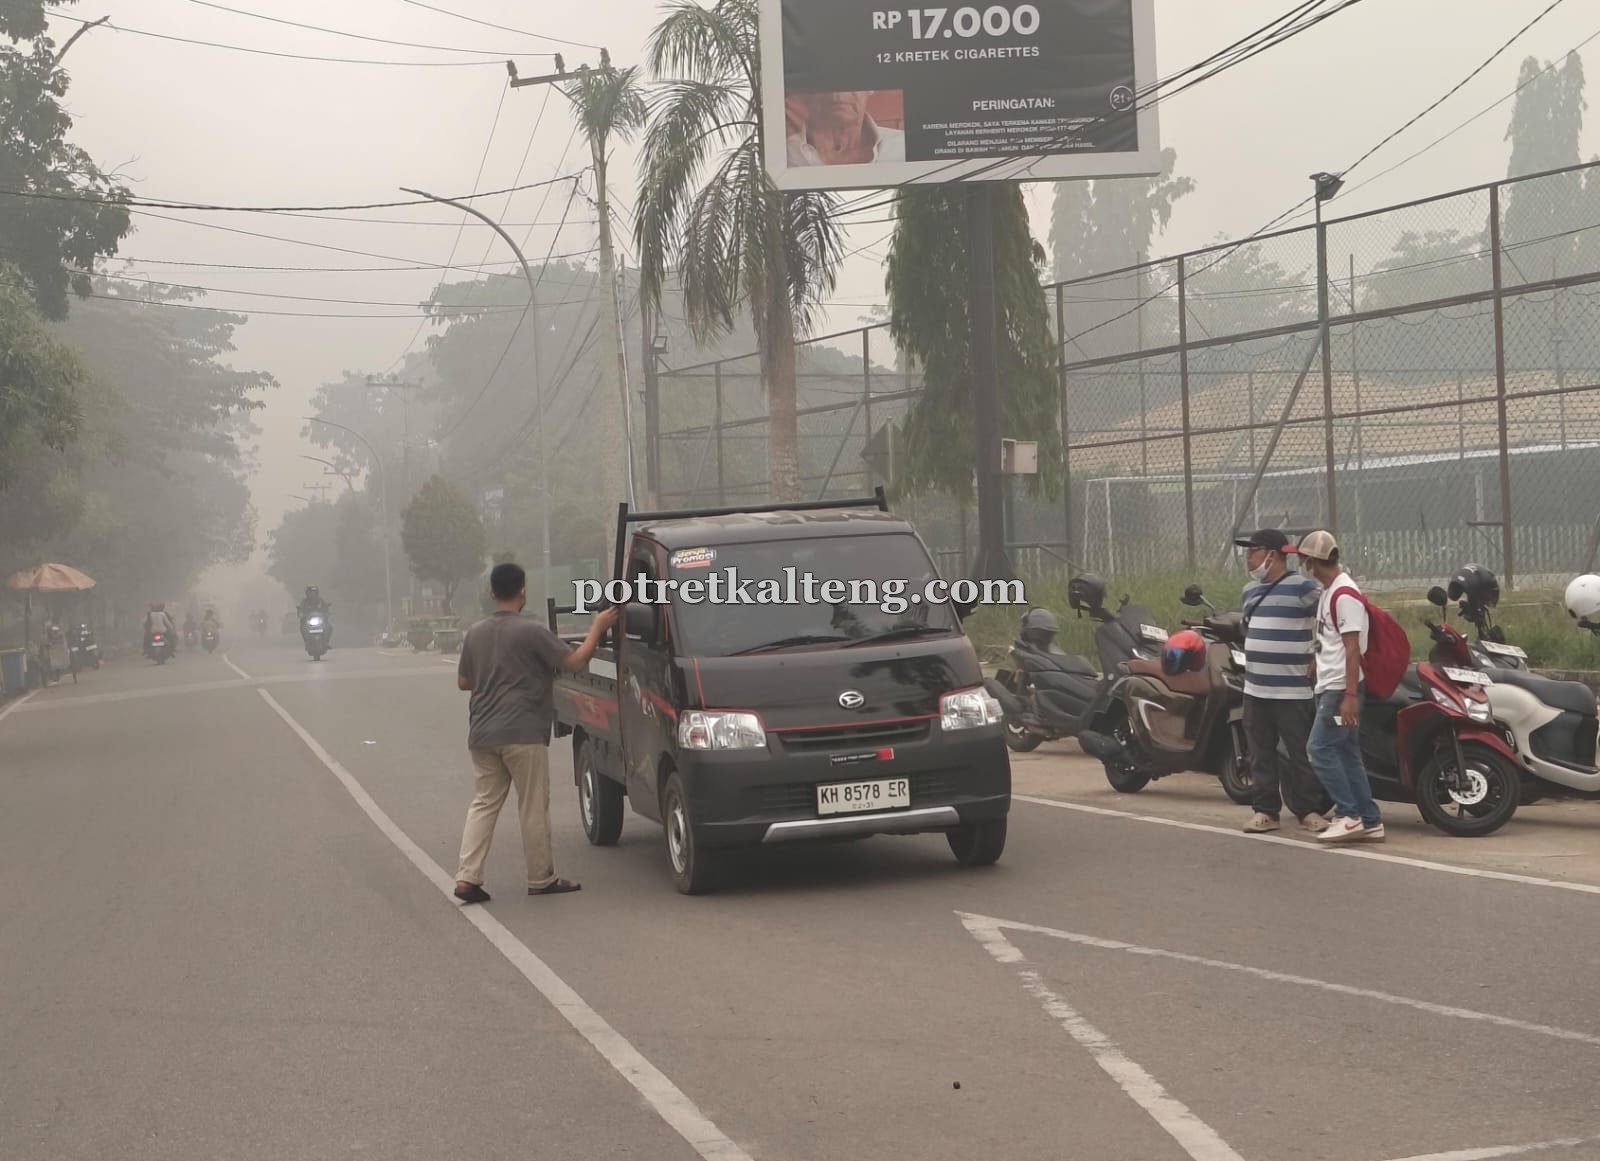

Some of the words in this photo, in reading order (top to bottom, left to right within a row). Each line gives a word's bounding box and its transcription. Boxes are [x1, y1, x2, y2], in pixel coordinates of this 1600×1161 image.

[872, 10, 901, 30] RP
[908, 4, 1040, 40] 17.000
[877, 53, 891, 63] 12
[896, 50, 949, 62] KRETEK
[954, 46, 1040, 60] CIGARETTES
[972, 97, 1056, 111] PERINGATAN:
[820, 787, 839, 804] KH
[844, 784, 881, 802] 8578
[888, 781, 906, 797] ER
